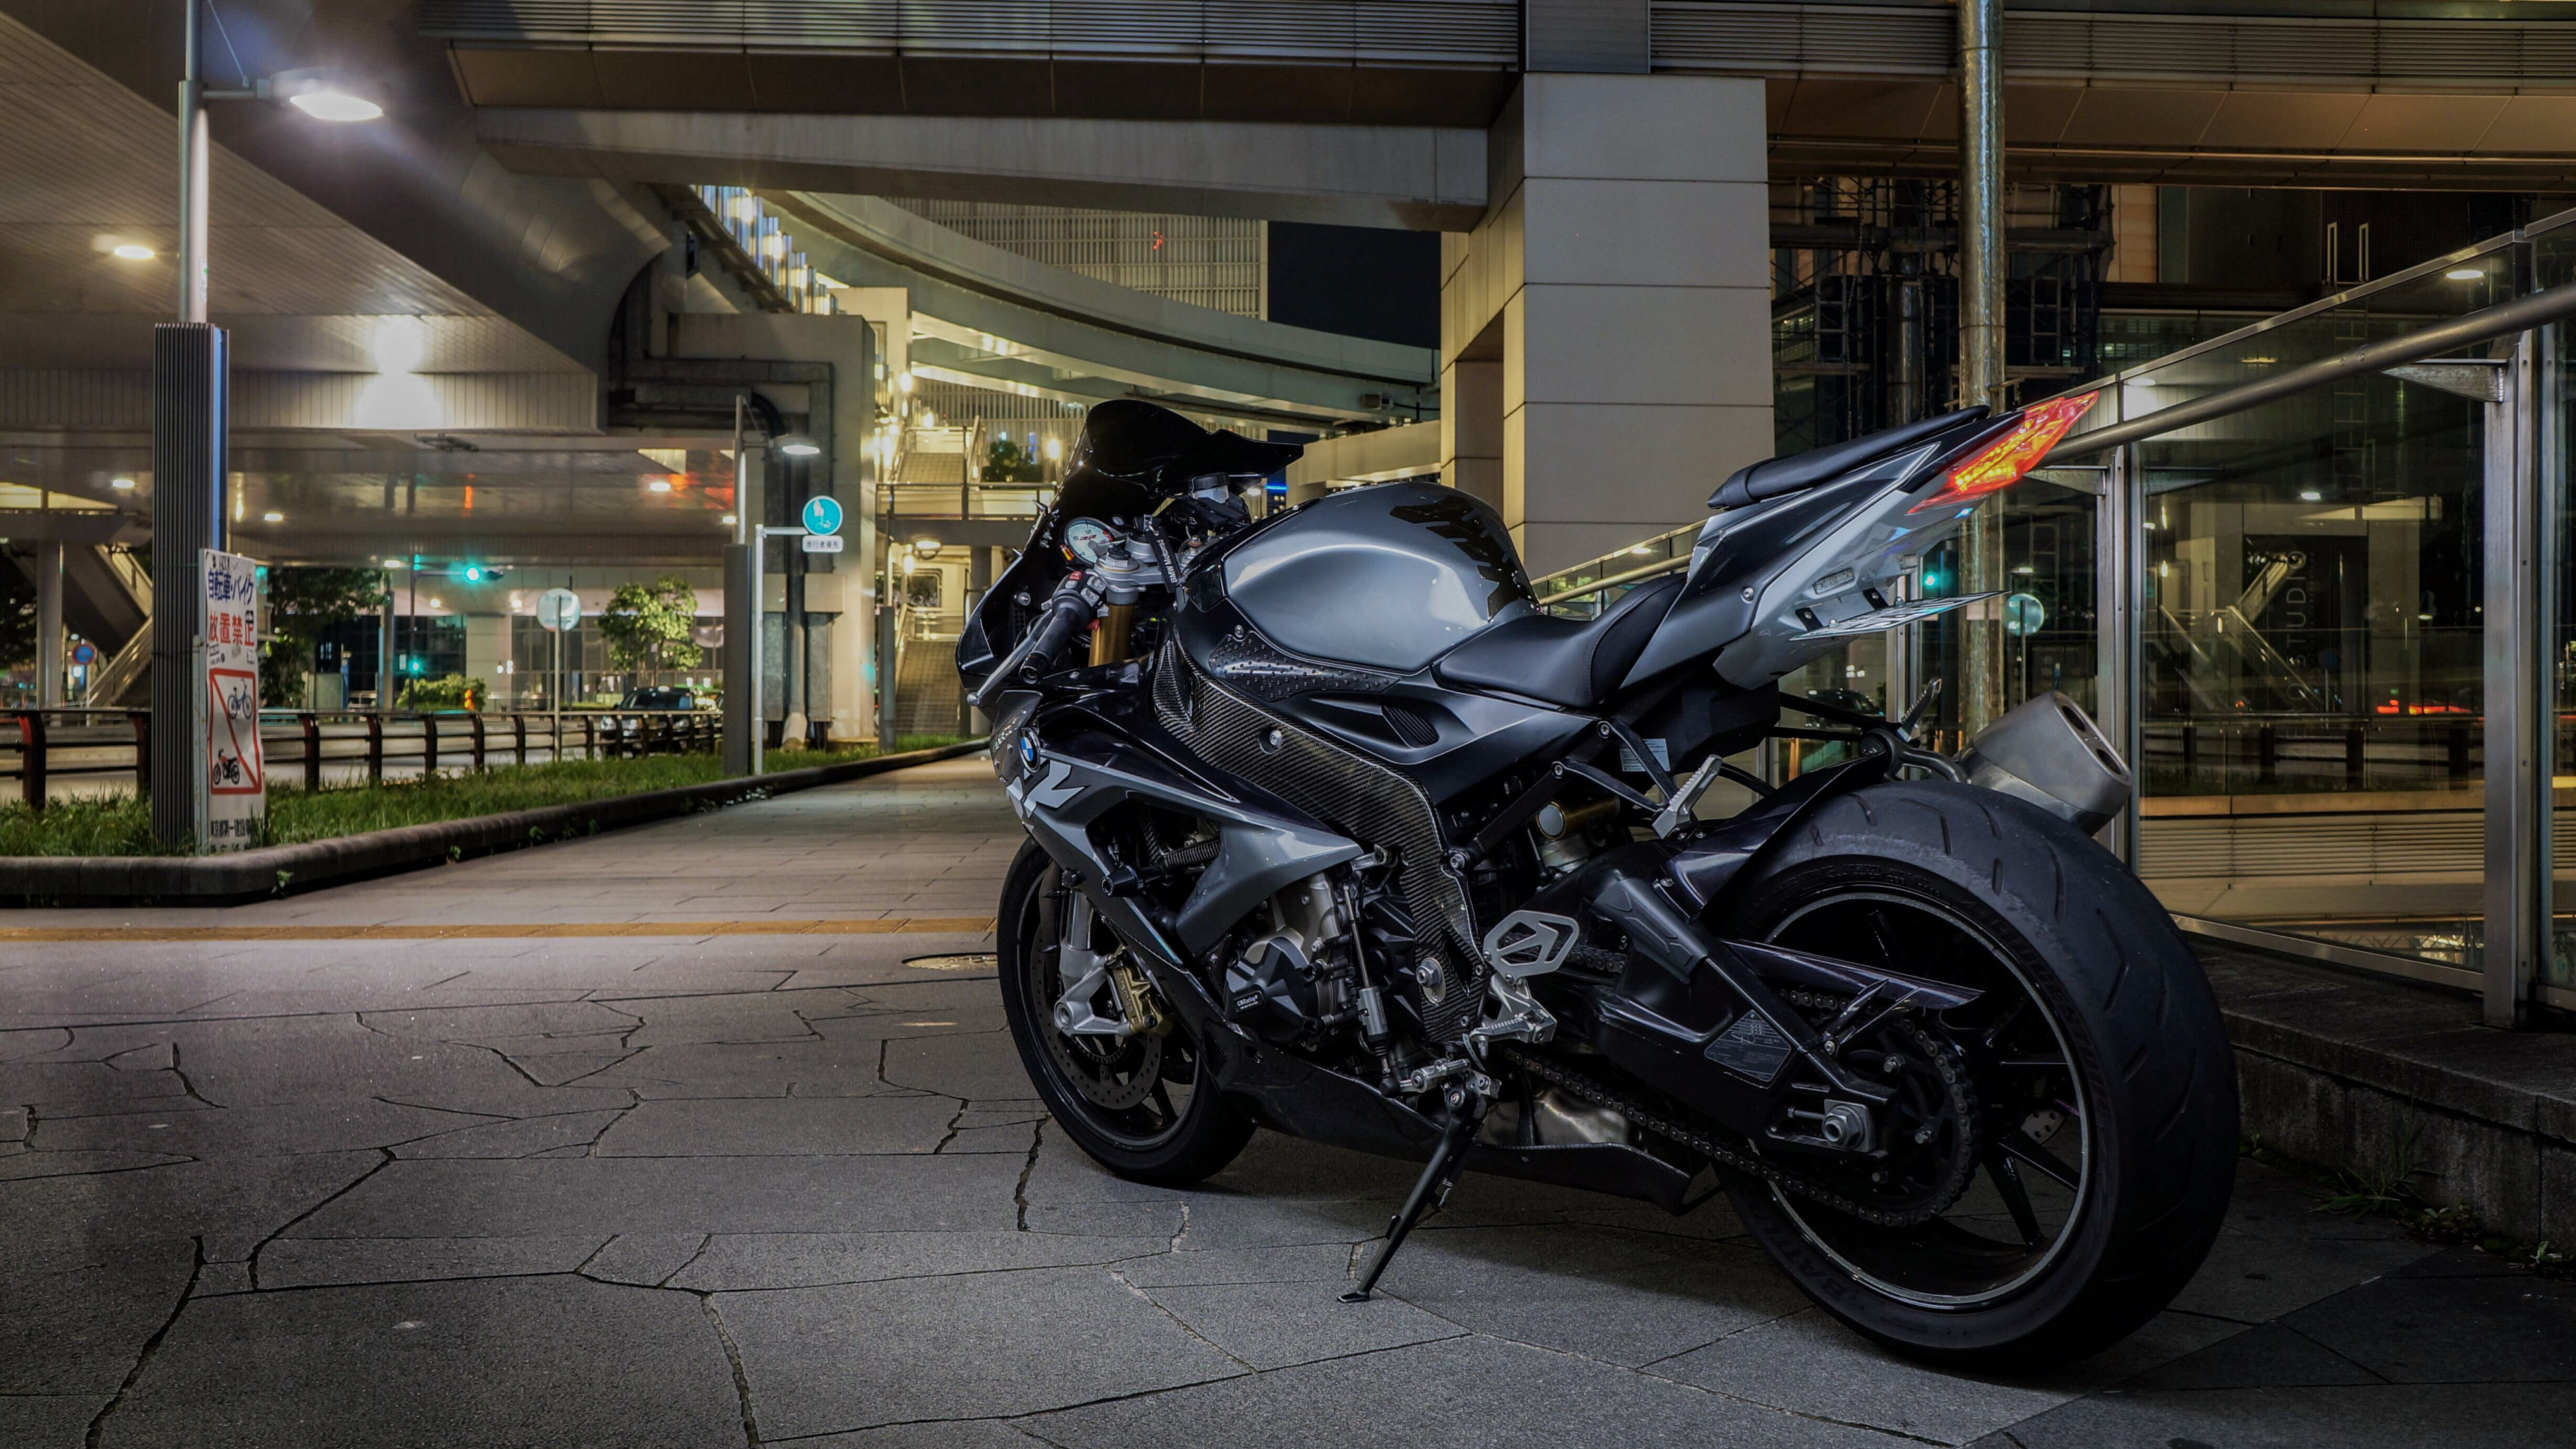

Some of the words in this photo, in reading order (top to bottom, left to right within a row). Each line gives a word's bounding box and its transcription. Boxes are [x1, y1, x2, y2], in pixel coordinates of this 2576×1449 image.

[1156, 539, 1172, 566] Motorrad
[1165, 566, 1178, 584] BMW
[2286, 550, 2307, 667] STUDIO
